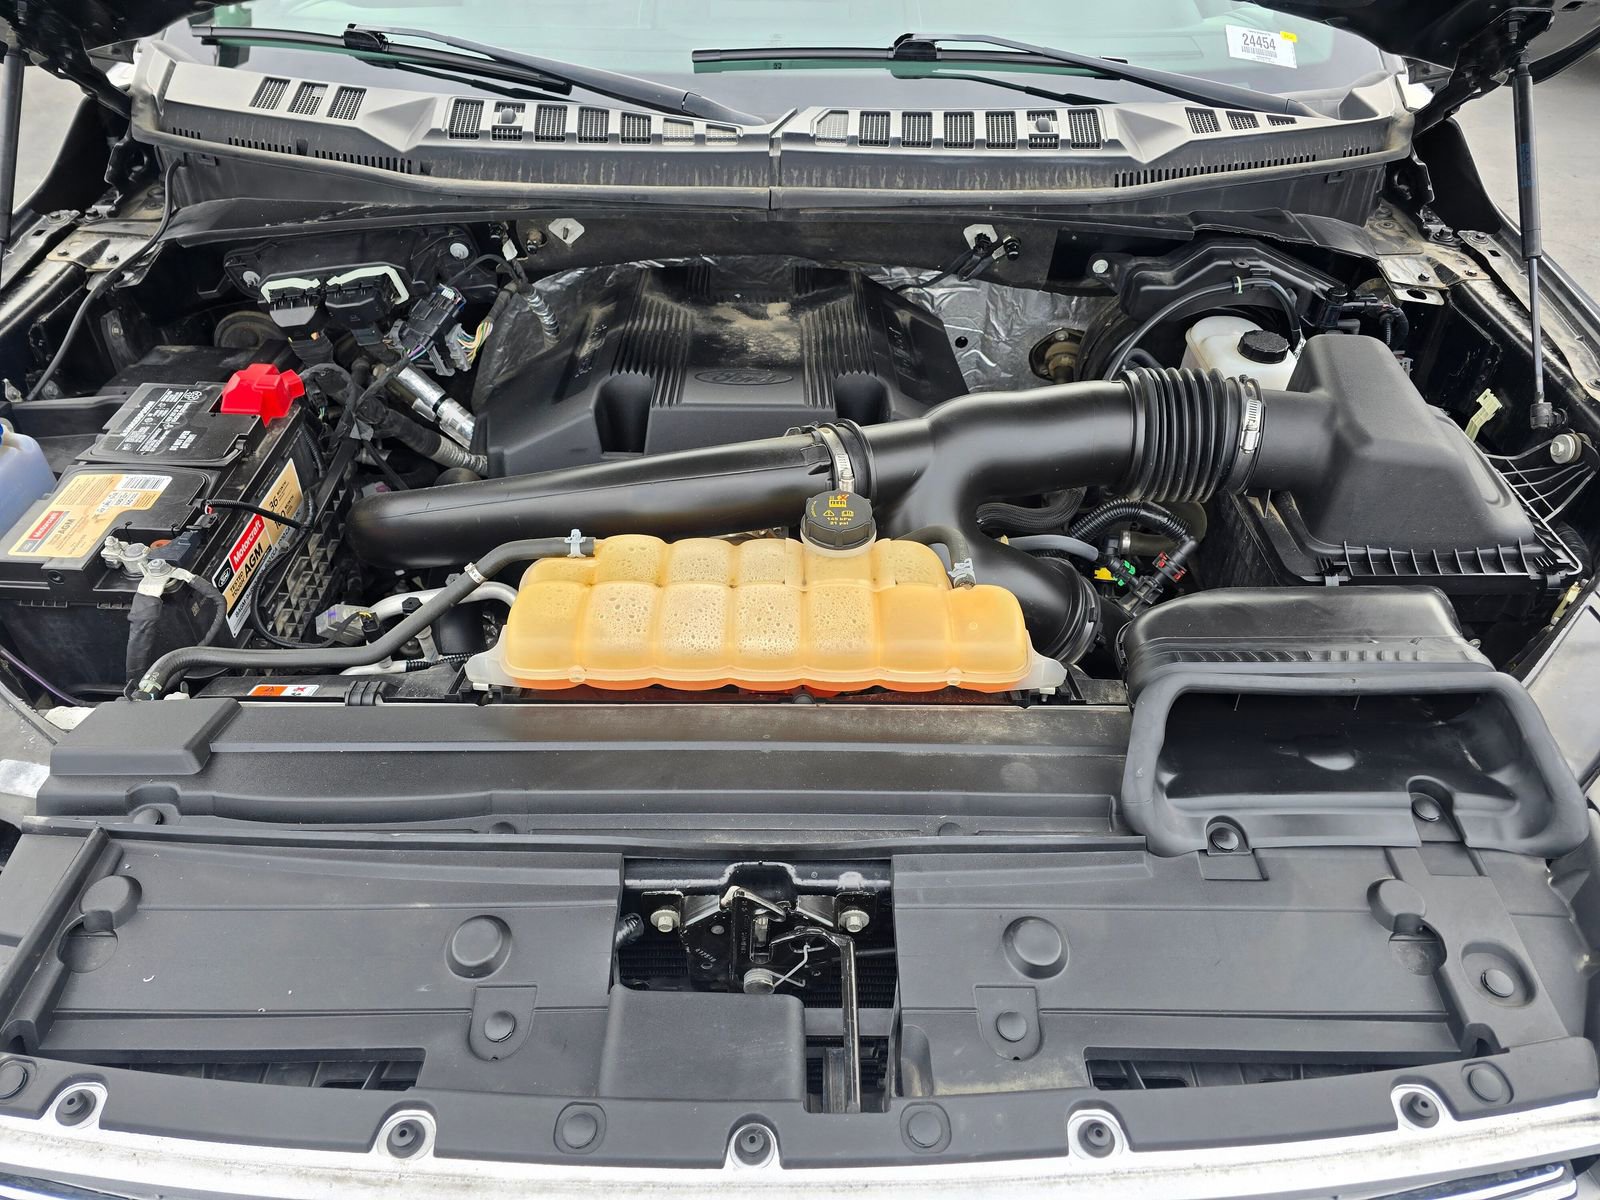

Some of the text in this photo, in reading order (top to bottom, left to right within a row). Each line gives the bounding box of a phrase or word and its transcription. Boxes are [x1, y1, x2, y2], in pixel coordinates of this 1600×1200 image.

[1242, 33, 1276, 50] 24454
[711, 370, 777, 384] Ford
[232, 519, 262, 565] Motorcraft
[244, 542, 263, 577] AGM
